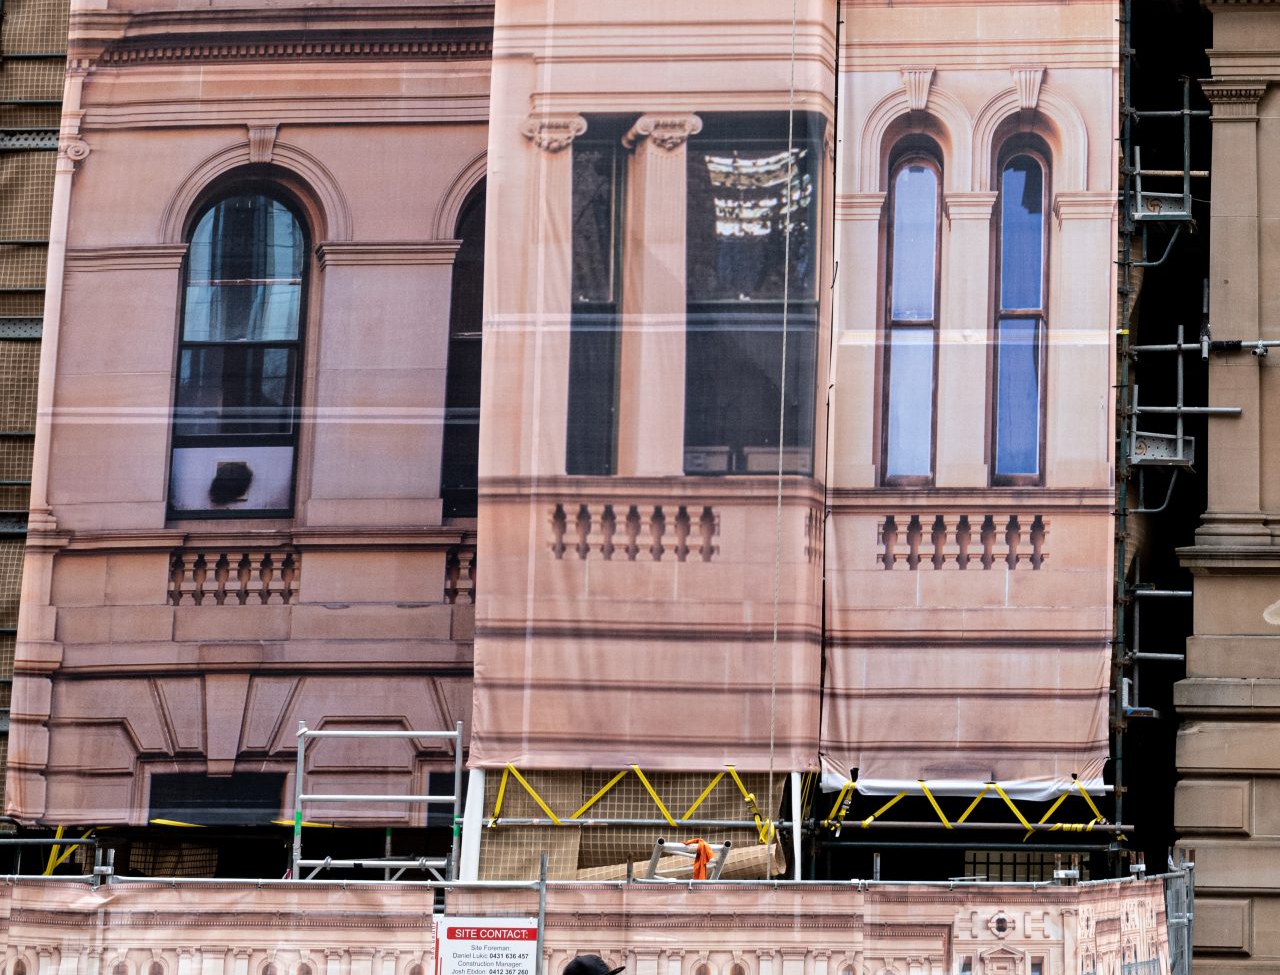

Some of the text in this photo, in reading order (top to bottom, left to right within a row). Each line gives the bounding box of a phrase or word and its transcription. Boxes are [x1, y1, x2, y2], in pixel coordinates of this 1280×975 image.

[455, 929, 529, 939] SITE CONTACT:
[484, 944, 512, 952] Foreman:
[453, 952, 472, 960] Daniel
